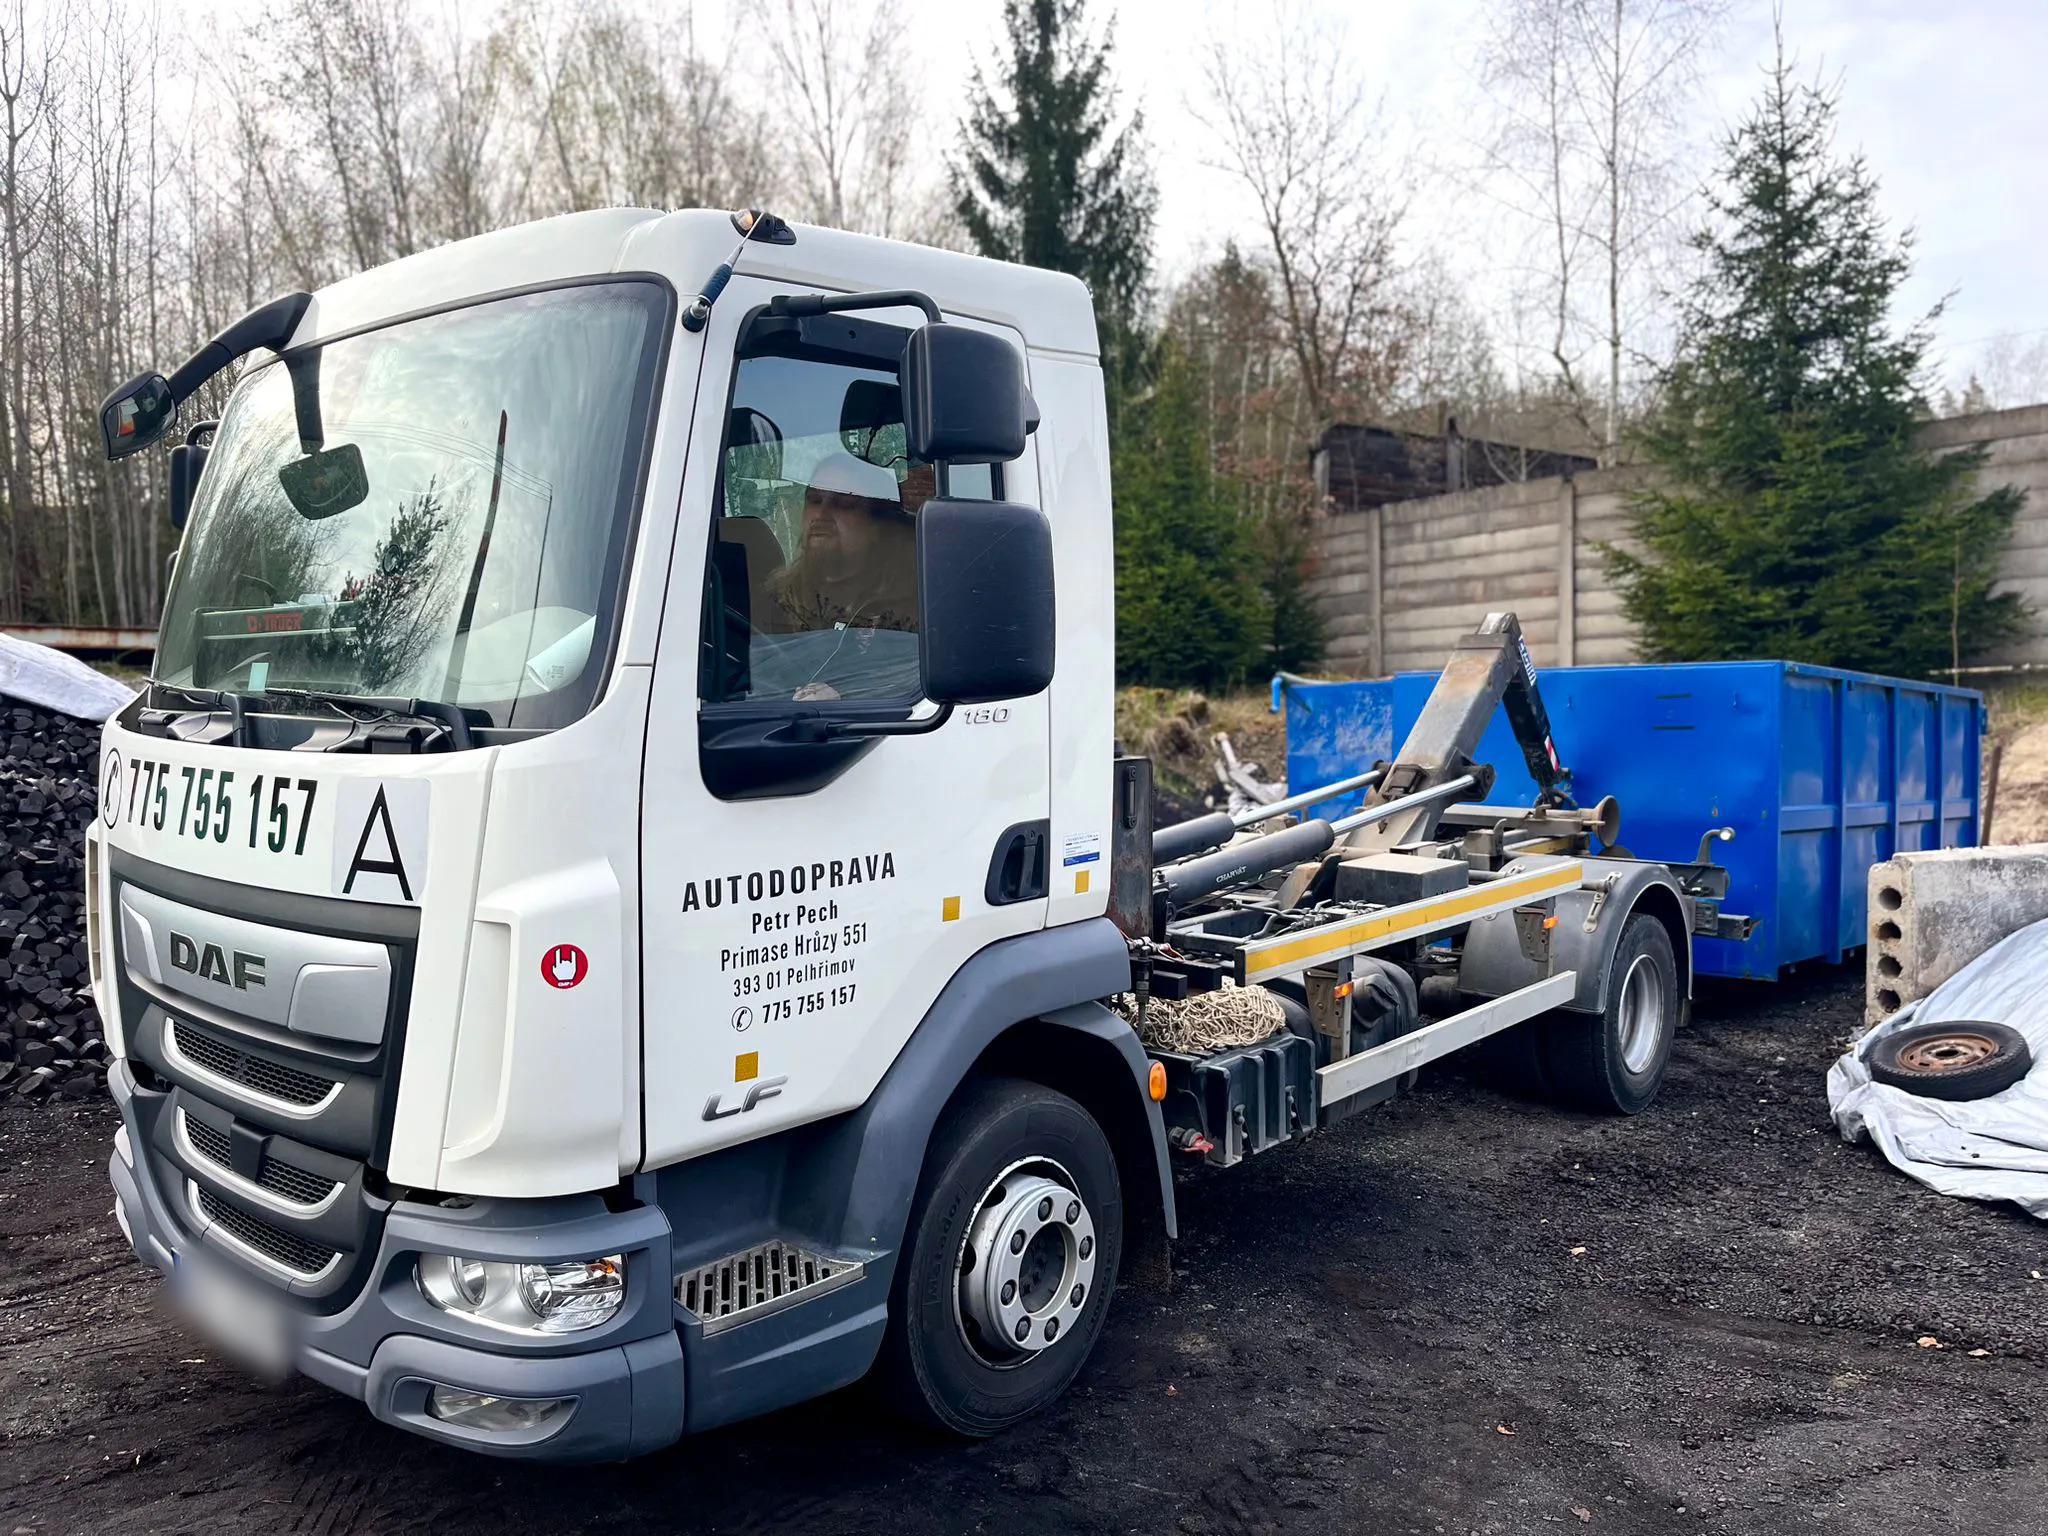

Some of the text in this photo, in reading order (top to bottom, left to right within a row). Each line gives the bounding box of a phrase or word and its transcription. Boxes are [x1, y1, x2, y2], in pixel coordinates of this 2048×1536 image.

[963, 706, 1011, 725] 180
[127, 758, 318, 856] 775 755 157
[342, 782, 414, 901] A
[682, 852, 896, 912] AUTODOPRAVA
[752, 900, 838, 934] Petr Pech
[170, 930, 266, 990] DAF
[721, 922, 867, 971] Primase Hrůzy 551
[733, 958, 856, 997] 393 01 Pelhřimov
[762, 983, 857, 1024] 775 755 157
[702, 1075, 788, 1121] LF
